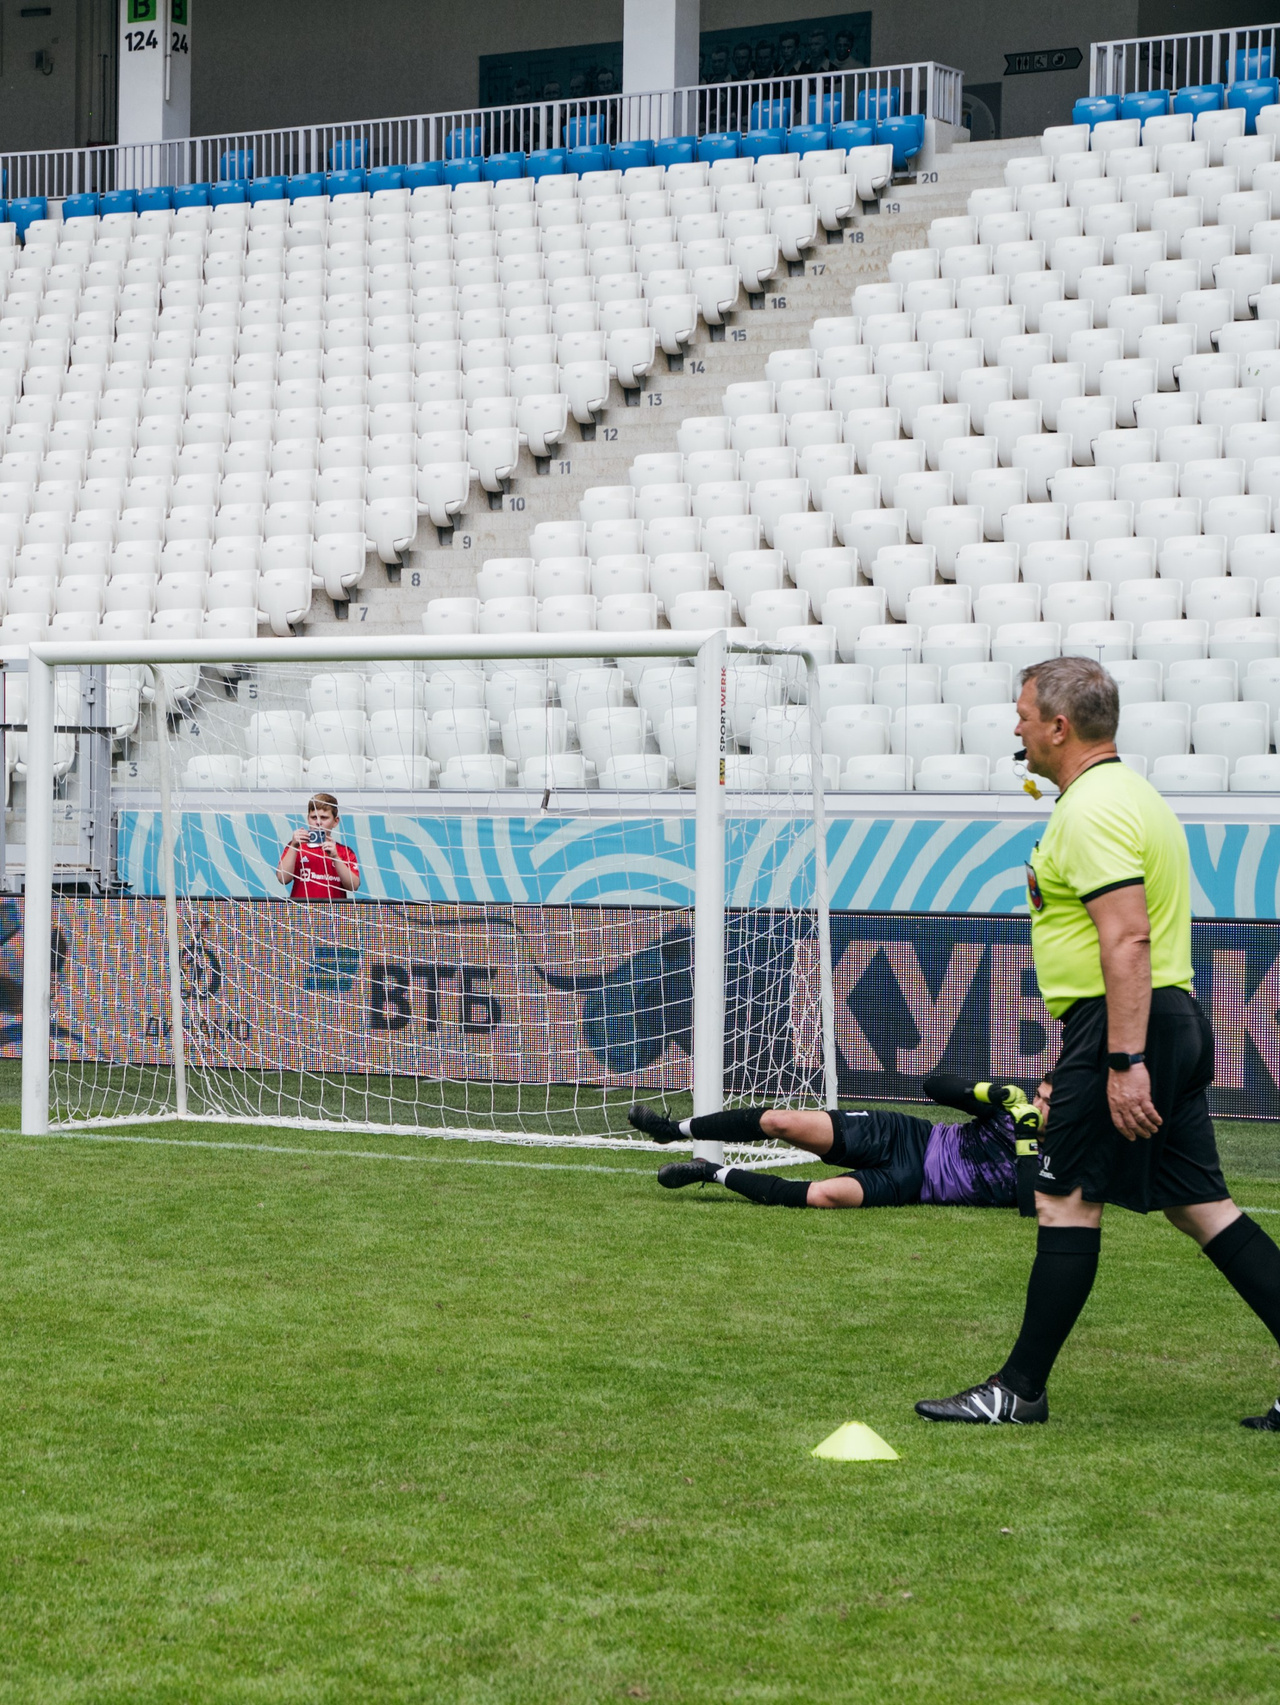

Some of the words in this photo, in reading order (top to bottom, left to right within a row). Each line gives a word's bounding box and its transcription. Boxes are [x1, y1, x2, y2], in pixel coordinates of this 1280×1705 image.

[125, 29, 158, 52] 124
[172, 31, 188, 54] 24
[921, 172, 939, 184] 20
[885, 203, 901, 214] 19
[848, 232, 865, 244] 18
[811, 264, 826, 276] 17
[771, 297, 787, 309] 16
[731, 329, 747, 342] 15
[690, 361, 705, 375] 14
[647, 393, 662, 406] 13
[602, 428, 618, 441] 12
[558, 461, 572, 475] 11
[509, 497, 526, 511] 10
[463, 535, 471, 549] 9
[411, 572, 421, 587] 8
[359, 607, 369, 621] 7
[249, 684, 258, 699] 5
[190, 722, 201, 737] 4
[129, 762, 138, 777] 3
[65, 804, 74, 820] 2
[371, 963, 502, 1034] ВТБ
[792, 939, 1280, 1089] КУБК
